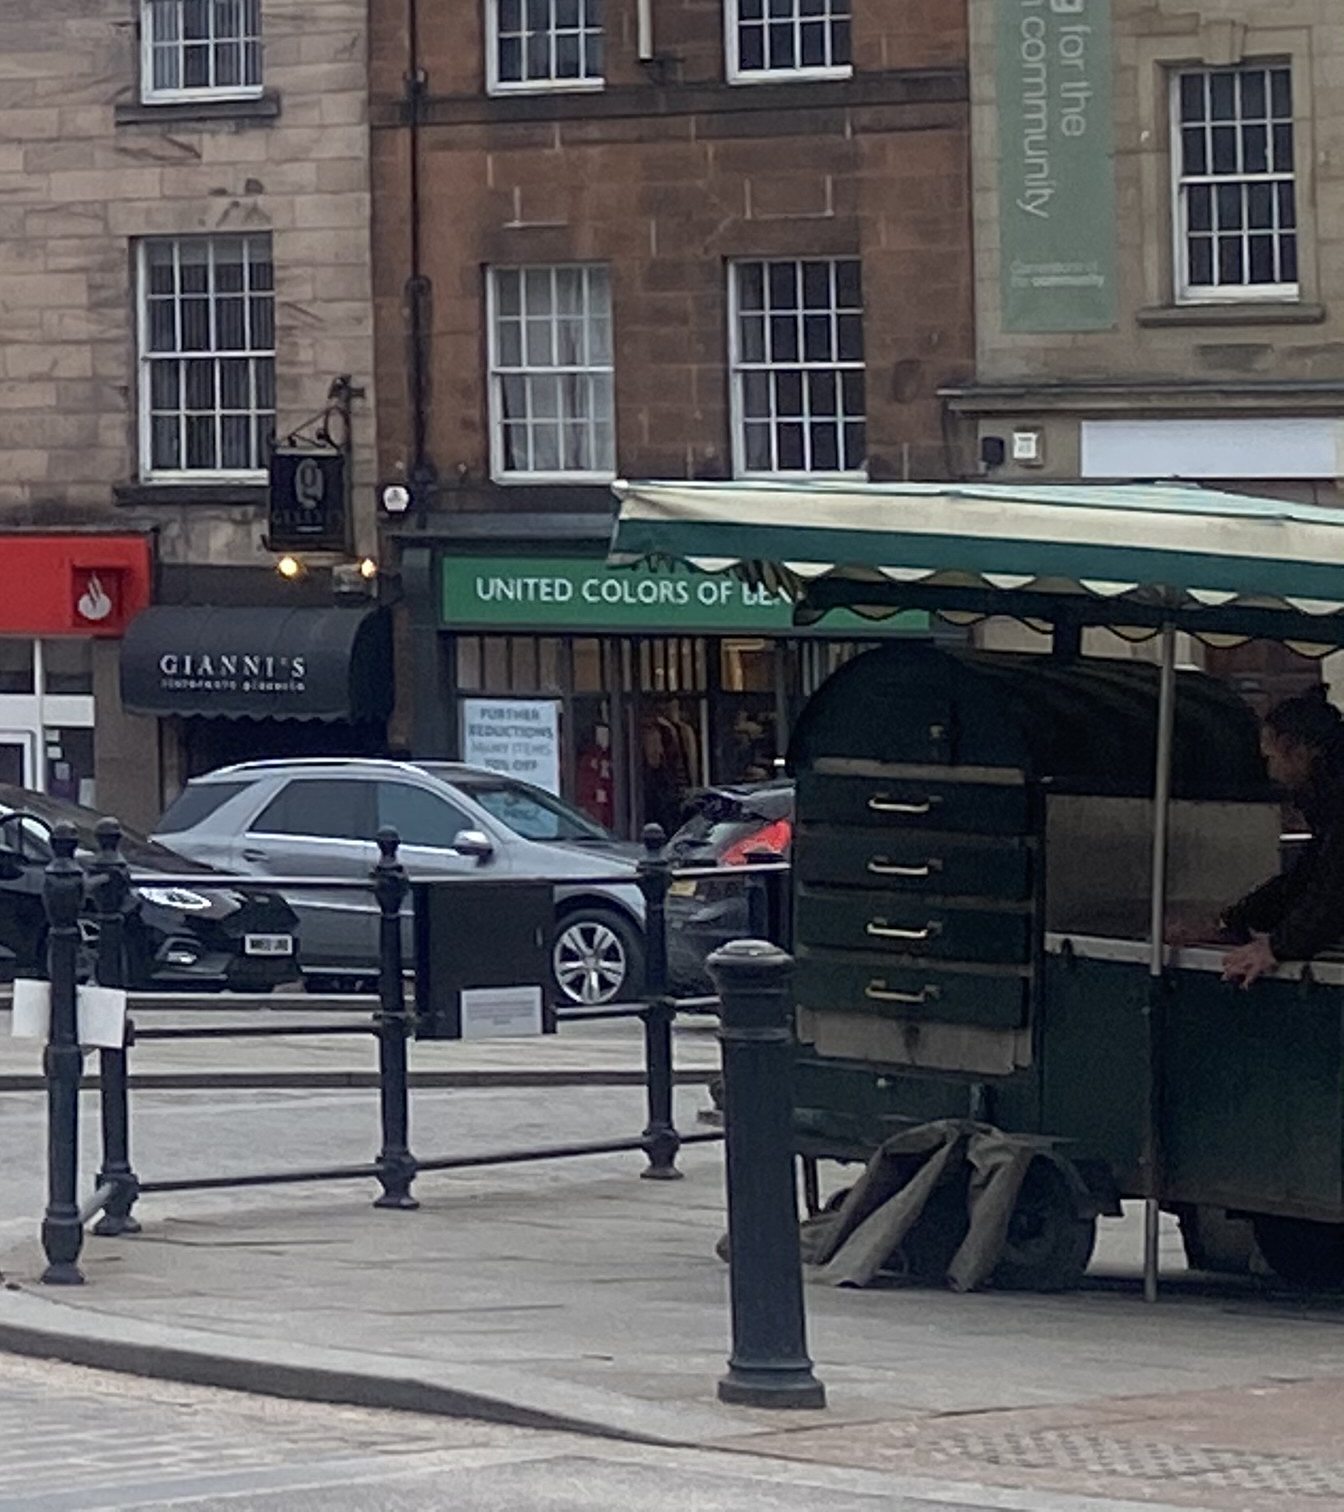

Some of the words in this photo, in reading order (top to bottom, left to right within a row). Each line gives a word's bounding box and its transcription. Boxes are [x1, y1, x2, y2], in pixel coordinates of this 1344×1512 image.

[1059, 24, 1091, 73] for
[1017, 15, 1054, 219] community
[1060, 79, 1092, 138] the
[475, 576, 572, 602] UNITED
[581, 578, 690, 604] COLORS
[697, 580, 733, 605] OF
[159, 654, 306, 678] GIANNI'S
